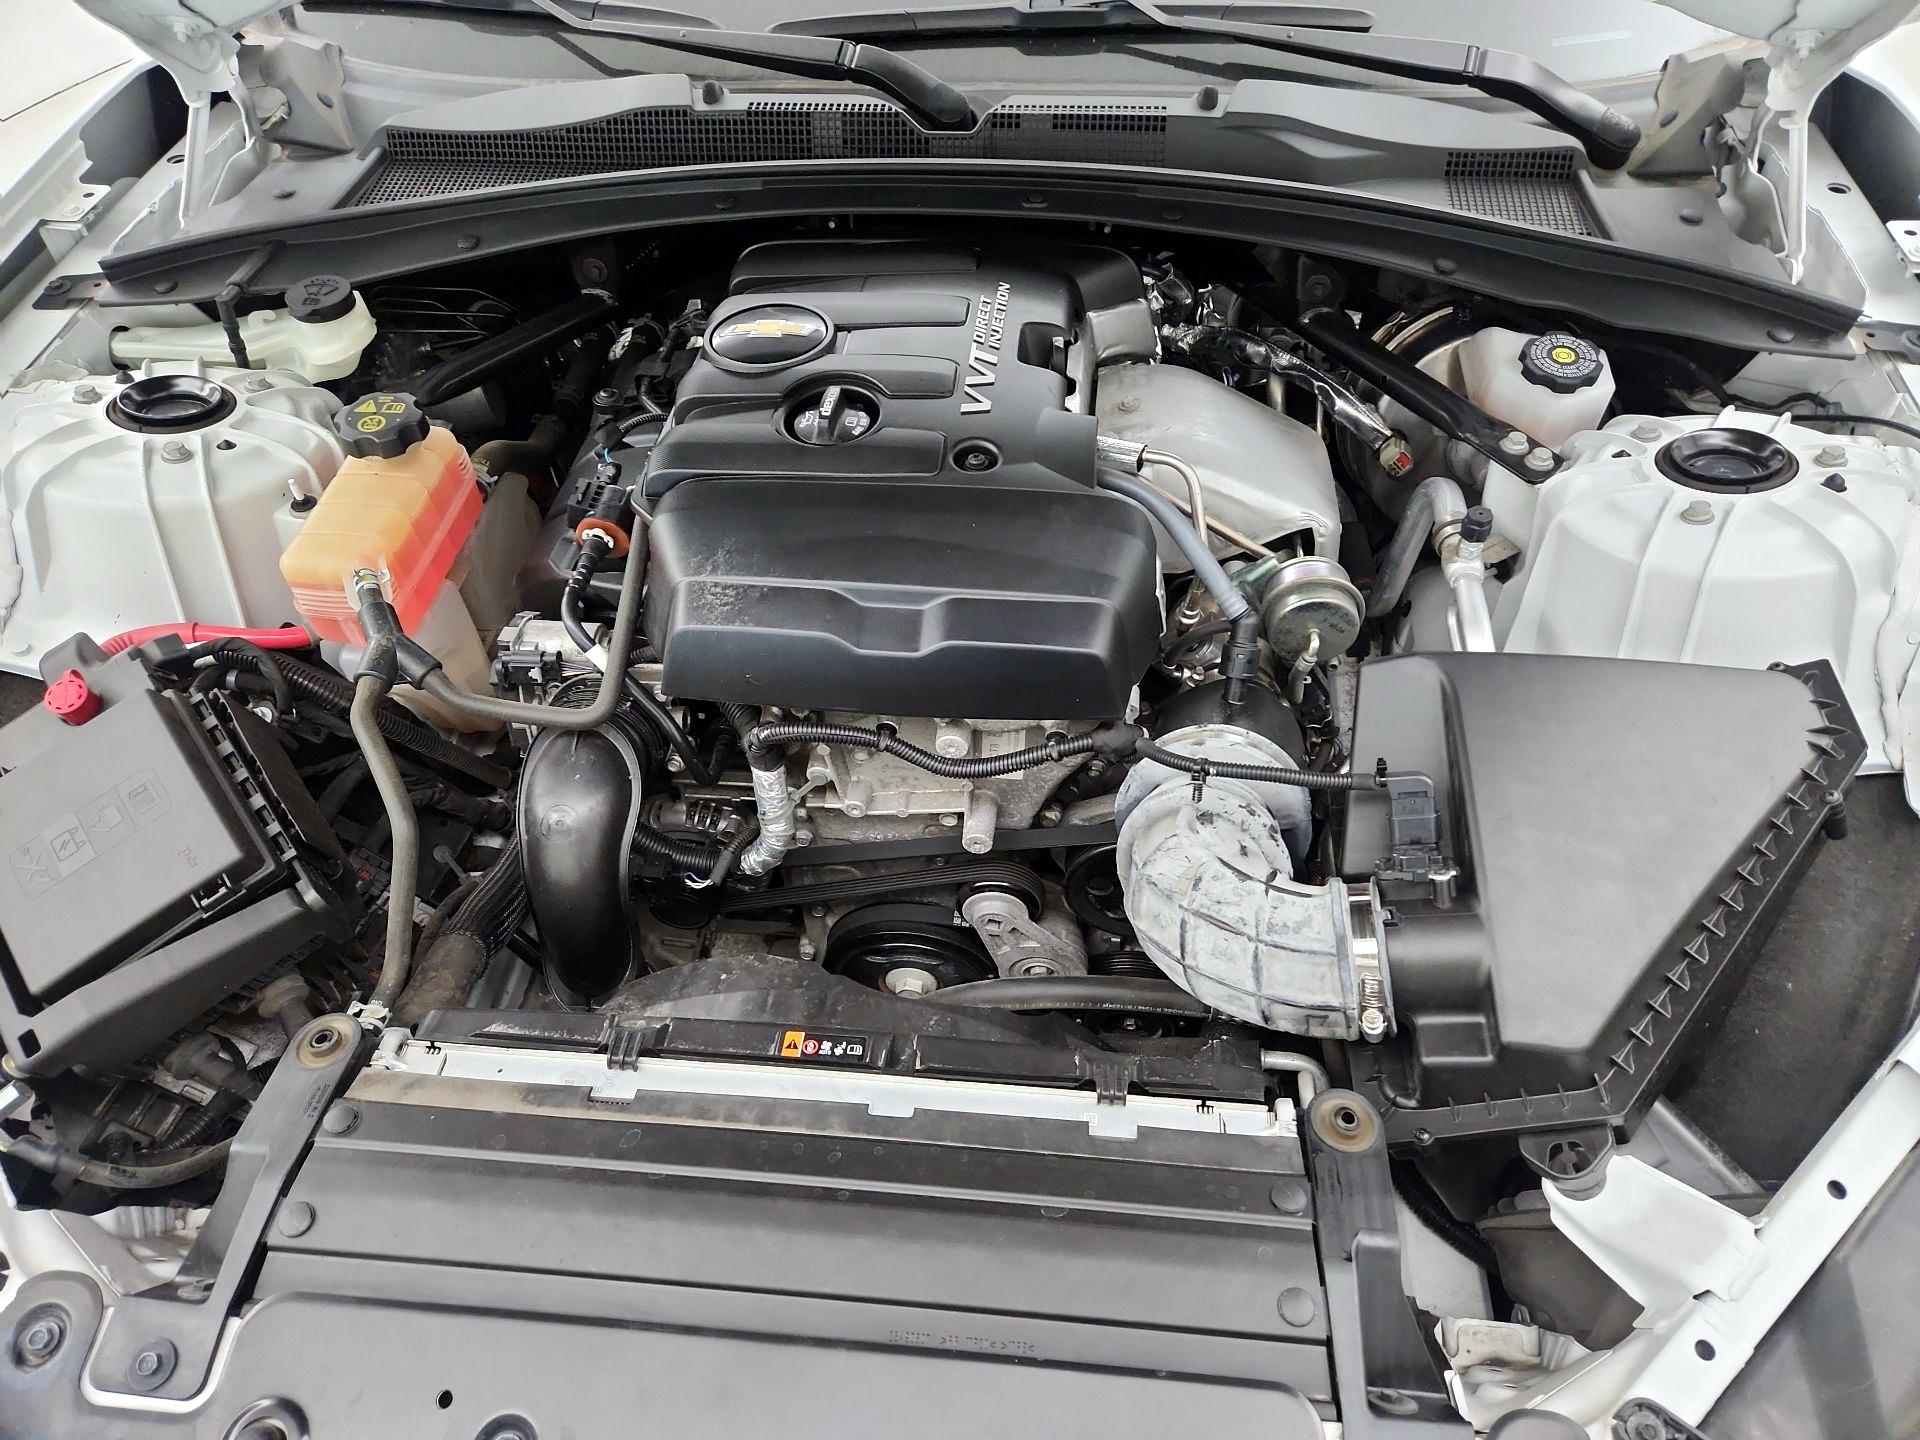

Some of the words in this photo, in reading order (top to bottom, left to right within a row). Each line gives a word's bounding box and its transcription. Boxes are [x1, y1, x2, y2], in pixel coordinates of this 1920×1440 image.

[973, 294, 992, 345] DIRECT
[988, 281, 1011, 350] INJECTION
[960, 340, 999, 415] VVT
